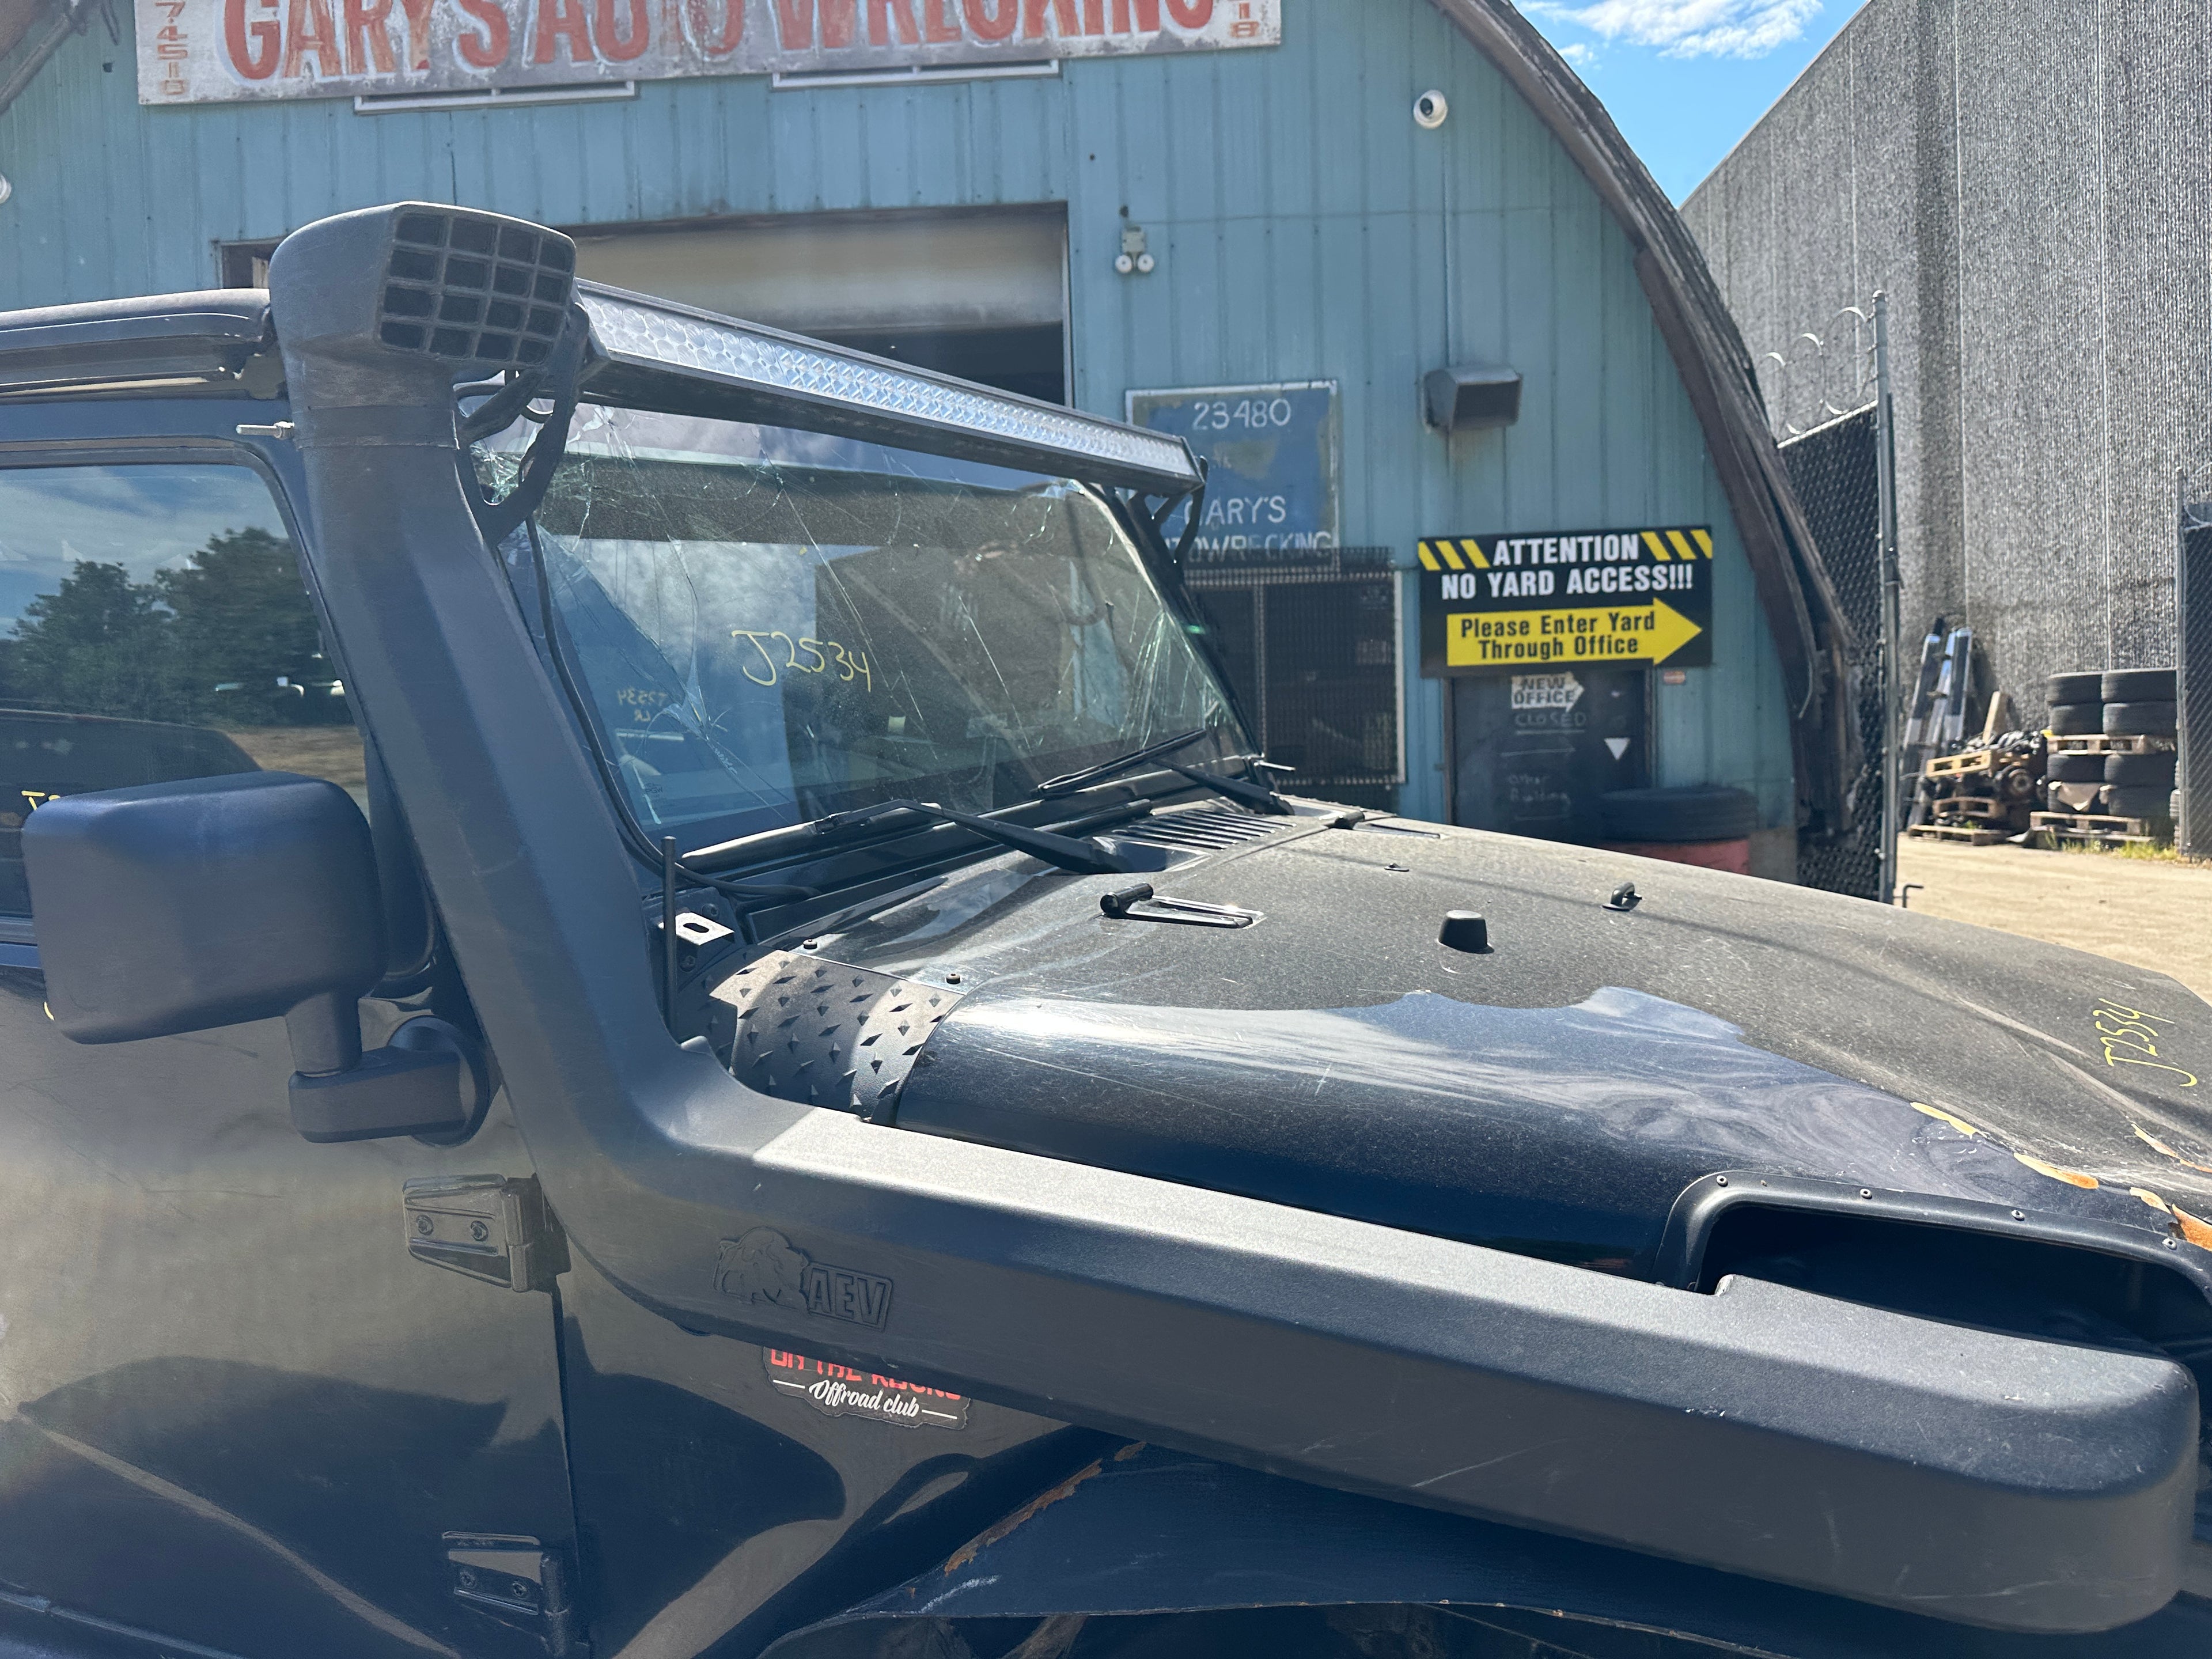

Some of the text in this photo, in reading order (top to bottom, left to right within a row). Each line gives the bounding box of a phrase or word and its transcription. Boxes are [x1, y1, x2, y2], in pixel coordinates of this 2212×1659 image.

[1192, 398, 1291, 430] 23480
[1493, 533, 1639, 566] ATTENTION
[1441, 563, 1693, 600] NO YARD ACCESS!!!
[1461, 611, 1655, 638] Please Enter Yard
[731, 630, 871, 692] J2534
[1478, 634, 1638, 660] Through Office
[1514, 690, 1574, 704] OFFICE
[1521, 677, 1565, 690] NEW
[1515, 711, 1586, 728] CLOSED
[2093, 998, 2198, 1087] J2534
[808, 1267, 886, 1325] AEV
[808, 1380, 884, 1410] Offroad
[882, 1394, 920, 1418] club
